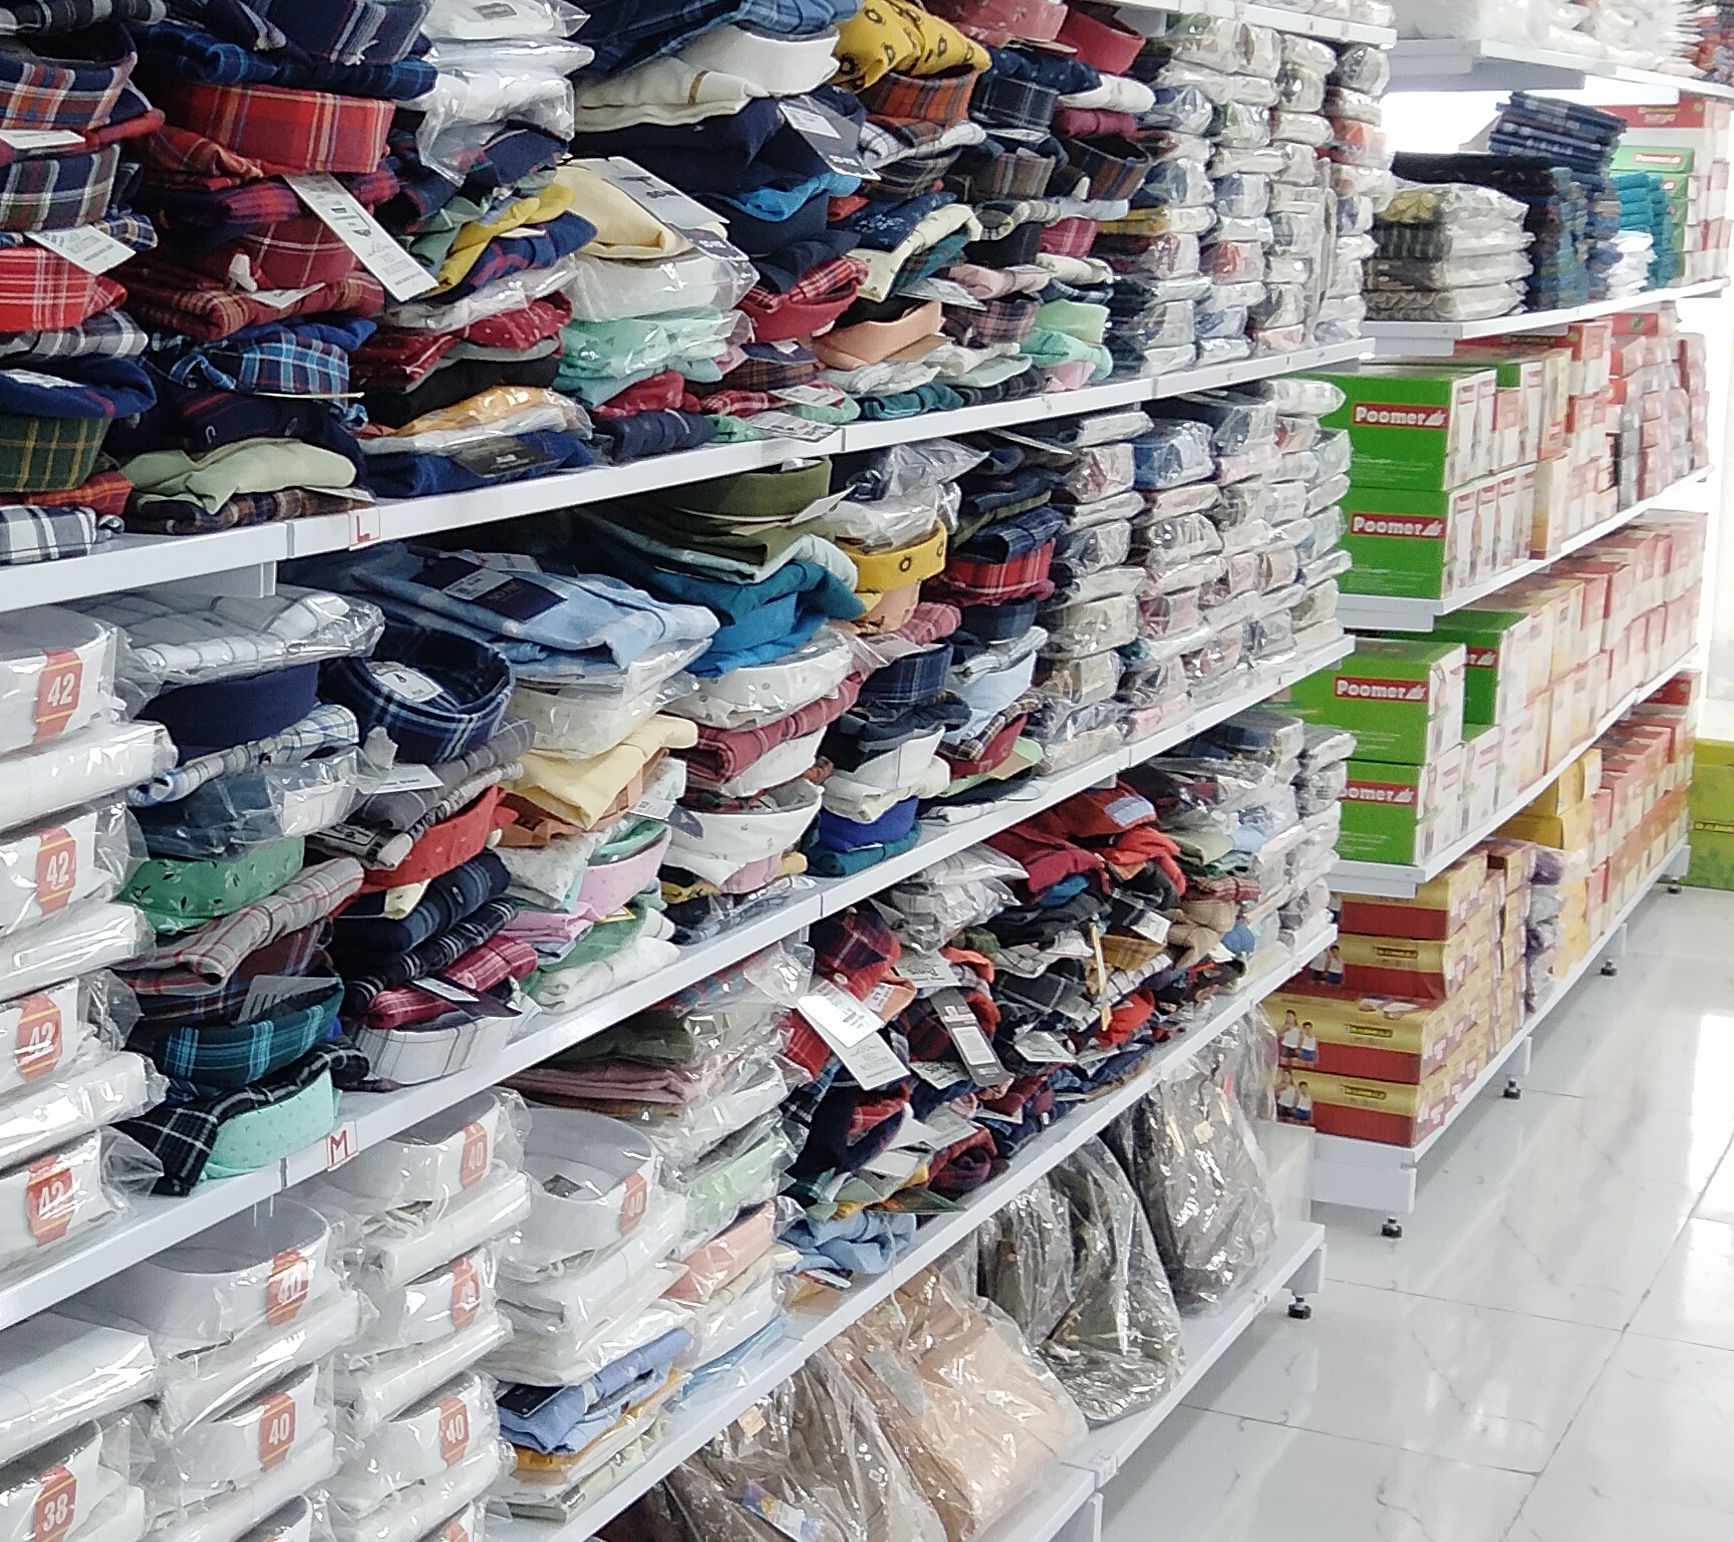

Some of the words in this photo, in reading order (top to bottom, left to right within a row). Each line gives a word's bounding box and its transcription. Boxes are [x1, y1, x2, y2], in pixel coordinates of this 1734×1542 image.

[1354, 406, 1425, 425] Poomer
[357, 515, 370, 543] L
[1352, 516, 1423, 535] Poomer
[47, 673, 75, 706] 42
[1336, 680, 1406, 698] Poomer
[1339, 786, 1395, 802] oomer
[47, 851, 70, 886] 42
[330, 1130, 350, 1164] M
[469, 1141, 484, 1170] 40
[627, 1191, 644, 1217] 40
[269, 1412, 290, 1445] 40
[447, 1414, 464, 1443] 40
[44, 1493, 68, 1531] 38
